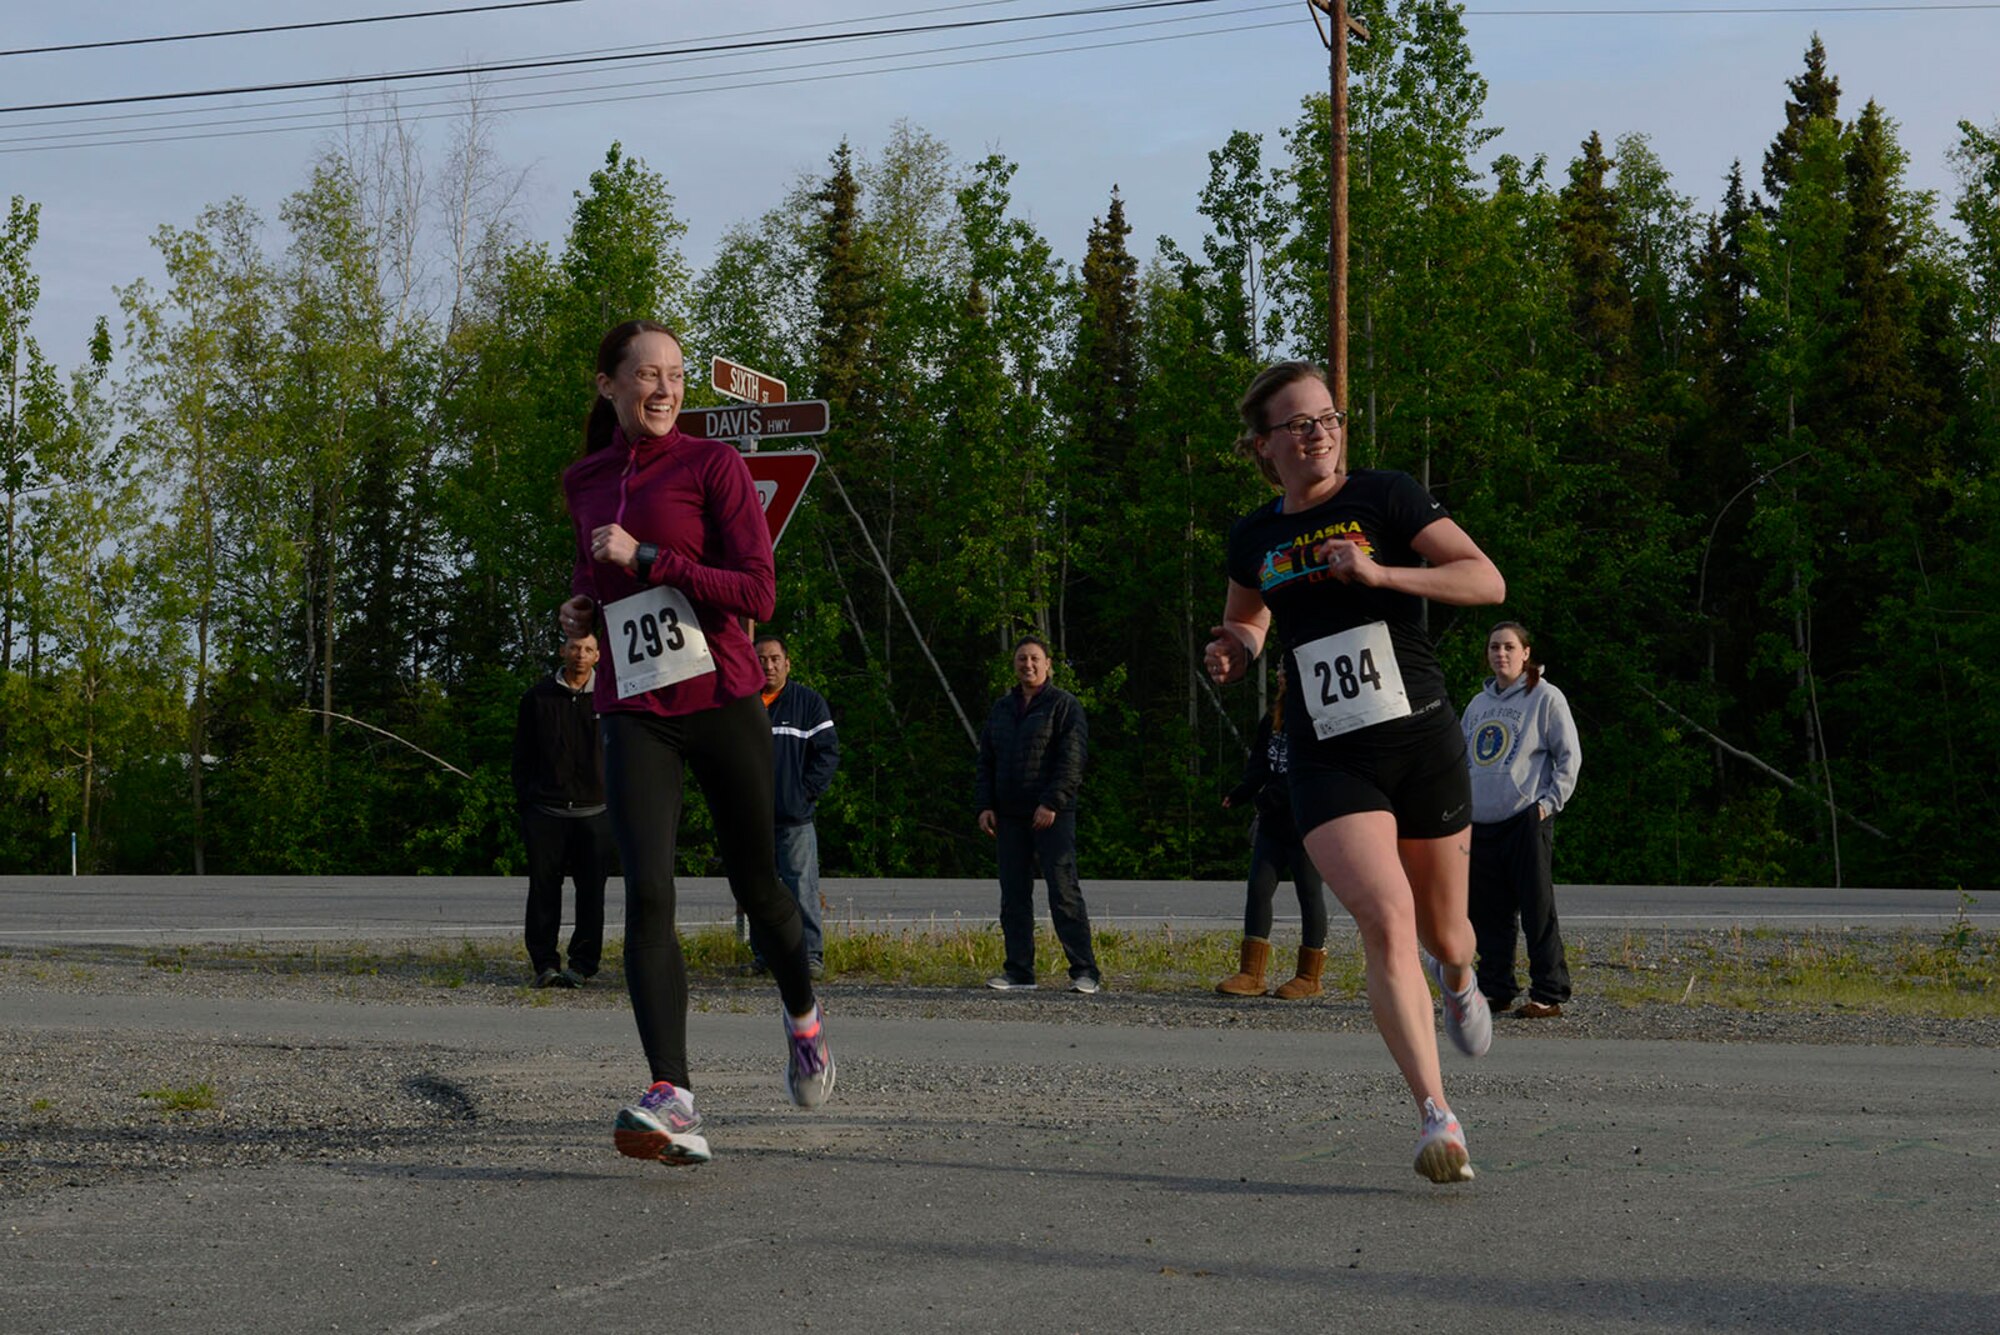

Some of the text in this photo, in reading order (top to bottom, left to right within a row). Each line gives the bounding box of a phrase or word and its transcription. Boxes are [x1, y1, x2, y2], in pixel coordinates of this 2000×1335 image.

[730, 367, 760, 400] SIXTH
[706, 409, 791, 437] DAVIS HWY
[1292, 520, 1363, 549] ALASKA
[623, 607, 685, 664] 293
[1314, 648, 1382, 706] 284
[1481, 708, 1496, 720] AIR
[1497, 707, 1522, 722] FORCE
